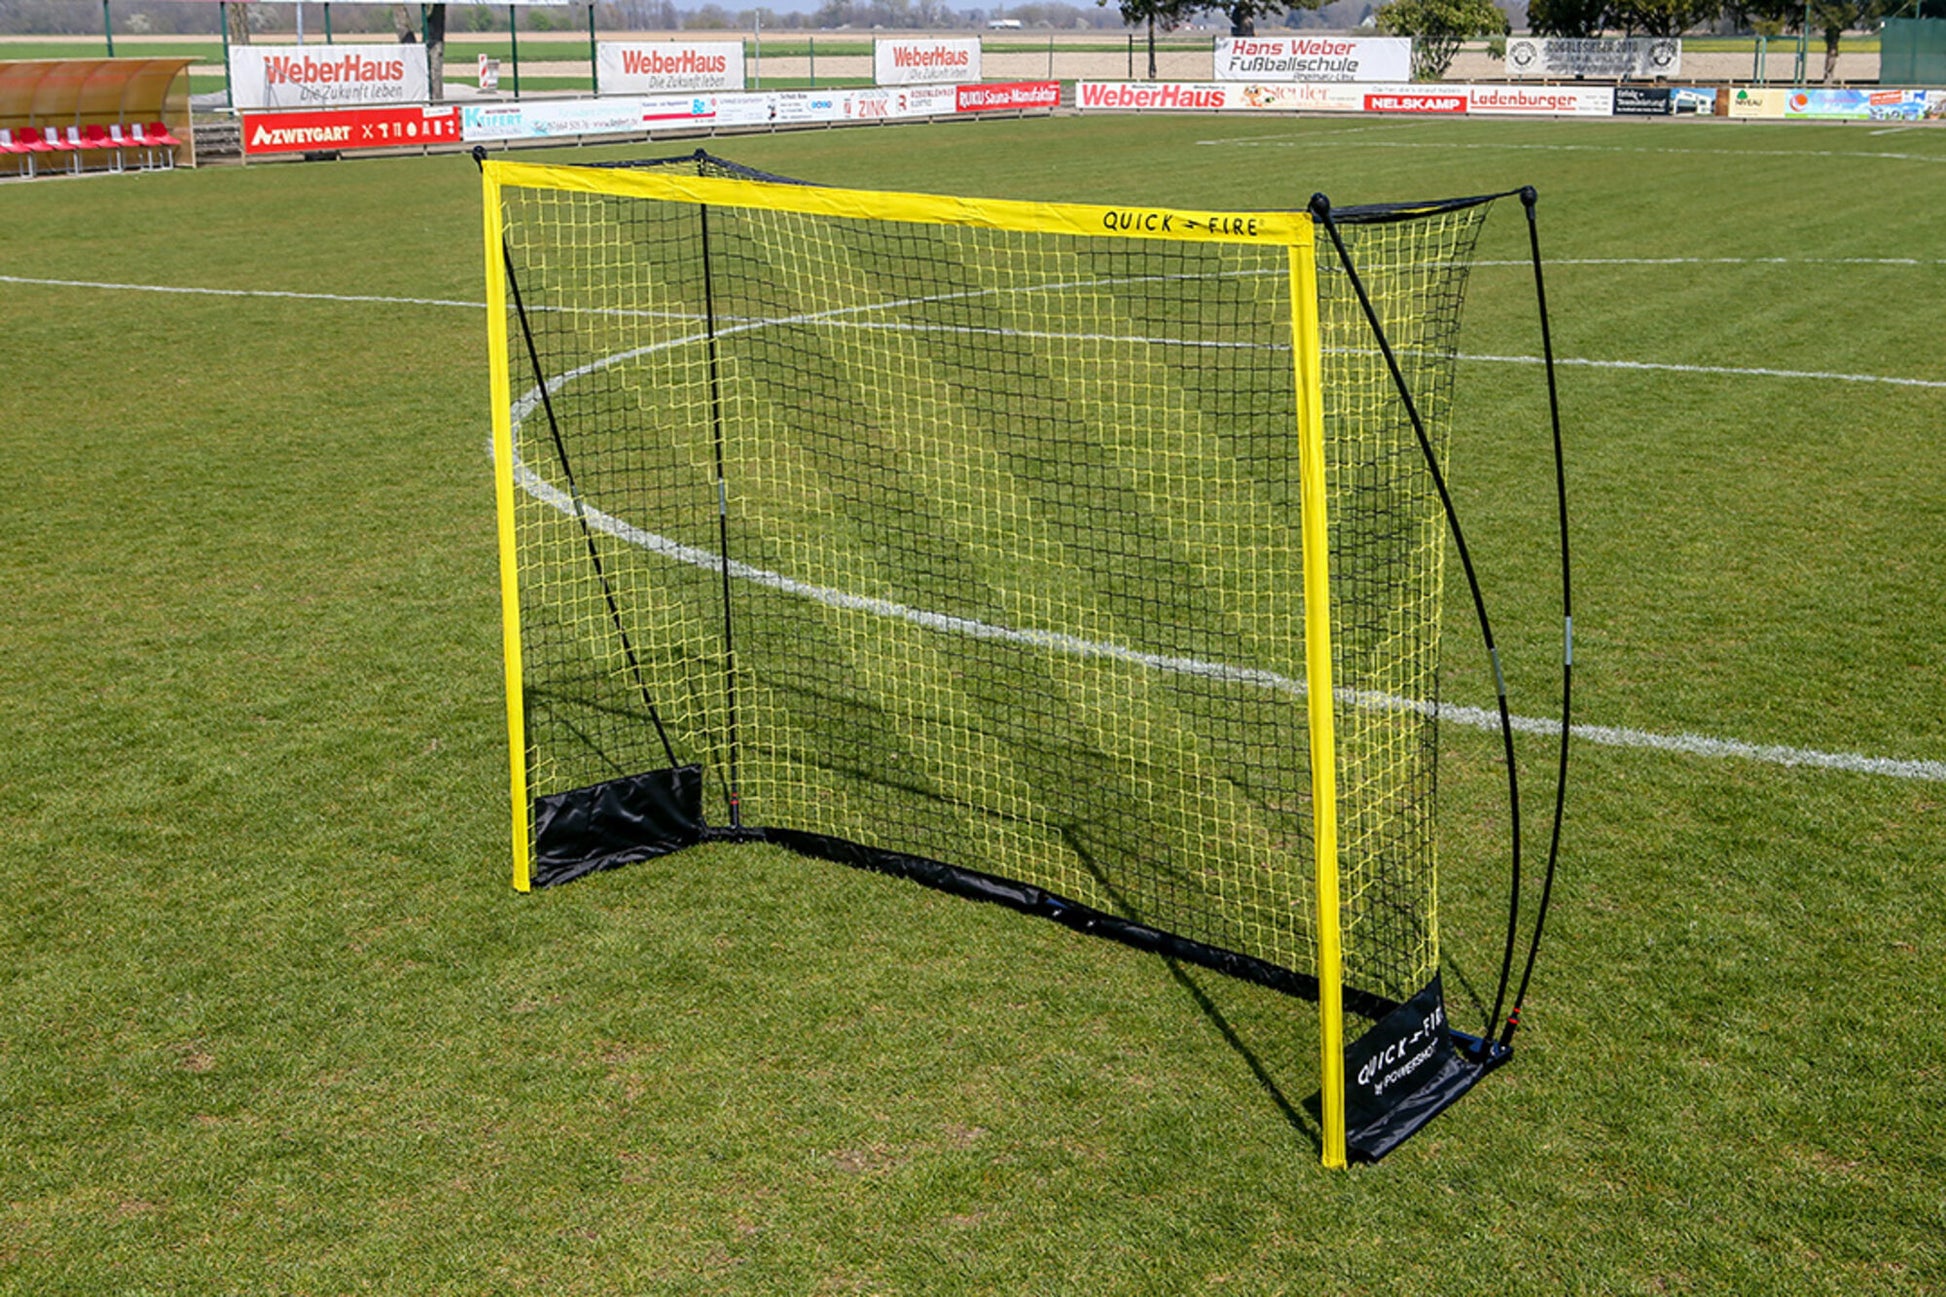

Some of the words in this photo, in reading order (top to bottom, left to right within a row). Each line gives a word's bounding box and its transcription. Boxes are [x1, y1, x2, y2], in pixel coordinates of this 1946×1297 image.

[893, 46, 968, 67] WeberHaus
[1232, 40, 1283, 55] Hans
[1291, 39, 1356, 55] Weber
[263, 54, 404, 84] WeberHaus
[622, 50, 726, 74] WeberHaus
[1229, 57, 1359, 72] Fußballschule
[300, 86, 320, 100] Die
[322, 84, 369, 101] Zukunft
[371, 83, 403, 98] leben
[649, 76, 665, 88] Die
[666, 75, 699, 89] Zukunft
[701, 75, 725, 88] leben
[1082, 84, 1226, 107] WeberHaus
[1371, 98, 1461, 110] NELSKAMP
[1470, 90, 1577, 109] Ladenburger
[859, 99, 888, 117] ZINK
[1103, 211, 1173, 231] QUICK
[1208, 217, 1257, 236] FIRE
[1358, 1037, 1407, 1085] QUICK
[1423, 1006, 1443, 1037] FIR
[1384, 1037, 1438, 1087] POWERSHOT
